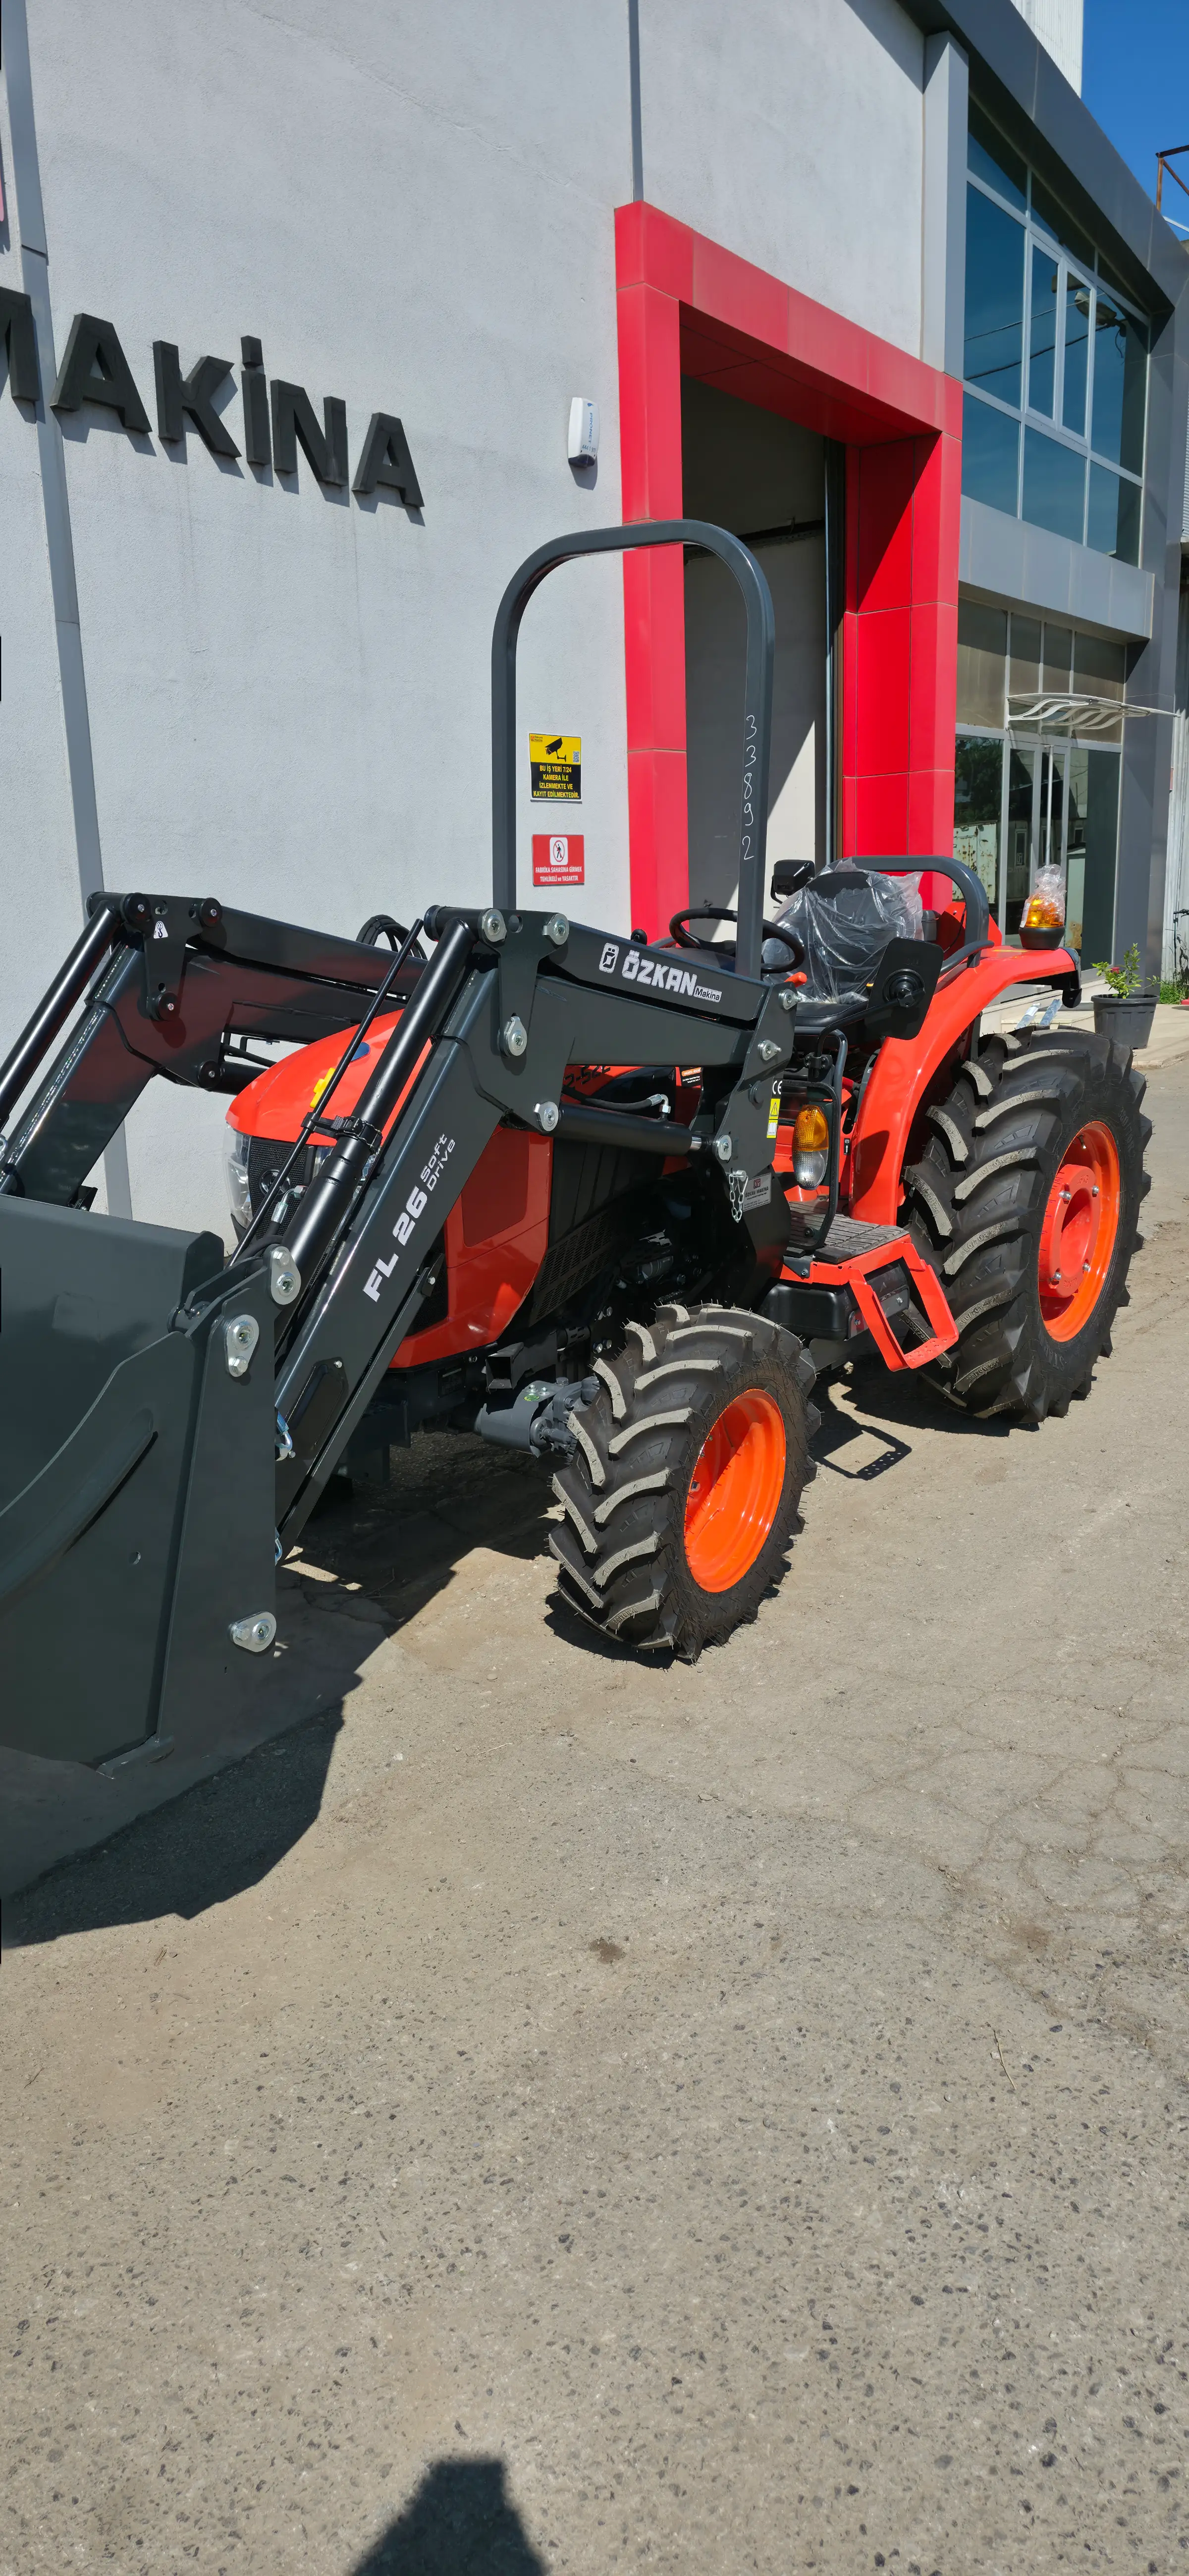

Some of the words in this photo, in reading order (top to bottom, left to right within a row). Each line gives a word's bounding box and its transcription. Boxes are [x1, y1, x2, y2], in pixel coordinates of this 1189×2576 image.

[547, 764, 551, 773] İŞ
[622, 950, 697, 996] ÖZKAN
[695, 987, 720, 1001] Makina
[773, 1080, 783, 1095] CE
[421, 1133, 447, 1182] Soft
[427, 1139, 455, 1191] Drive
[362, 1253, 399, 1302] FL
[392, 1185, 427, 1246] 26
